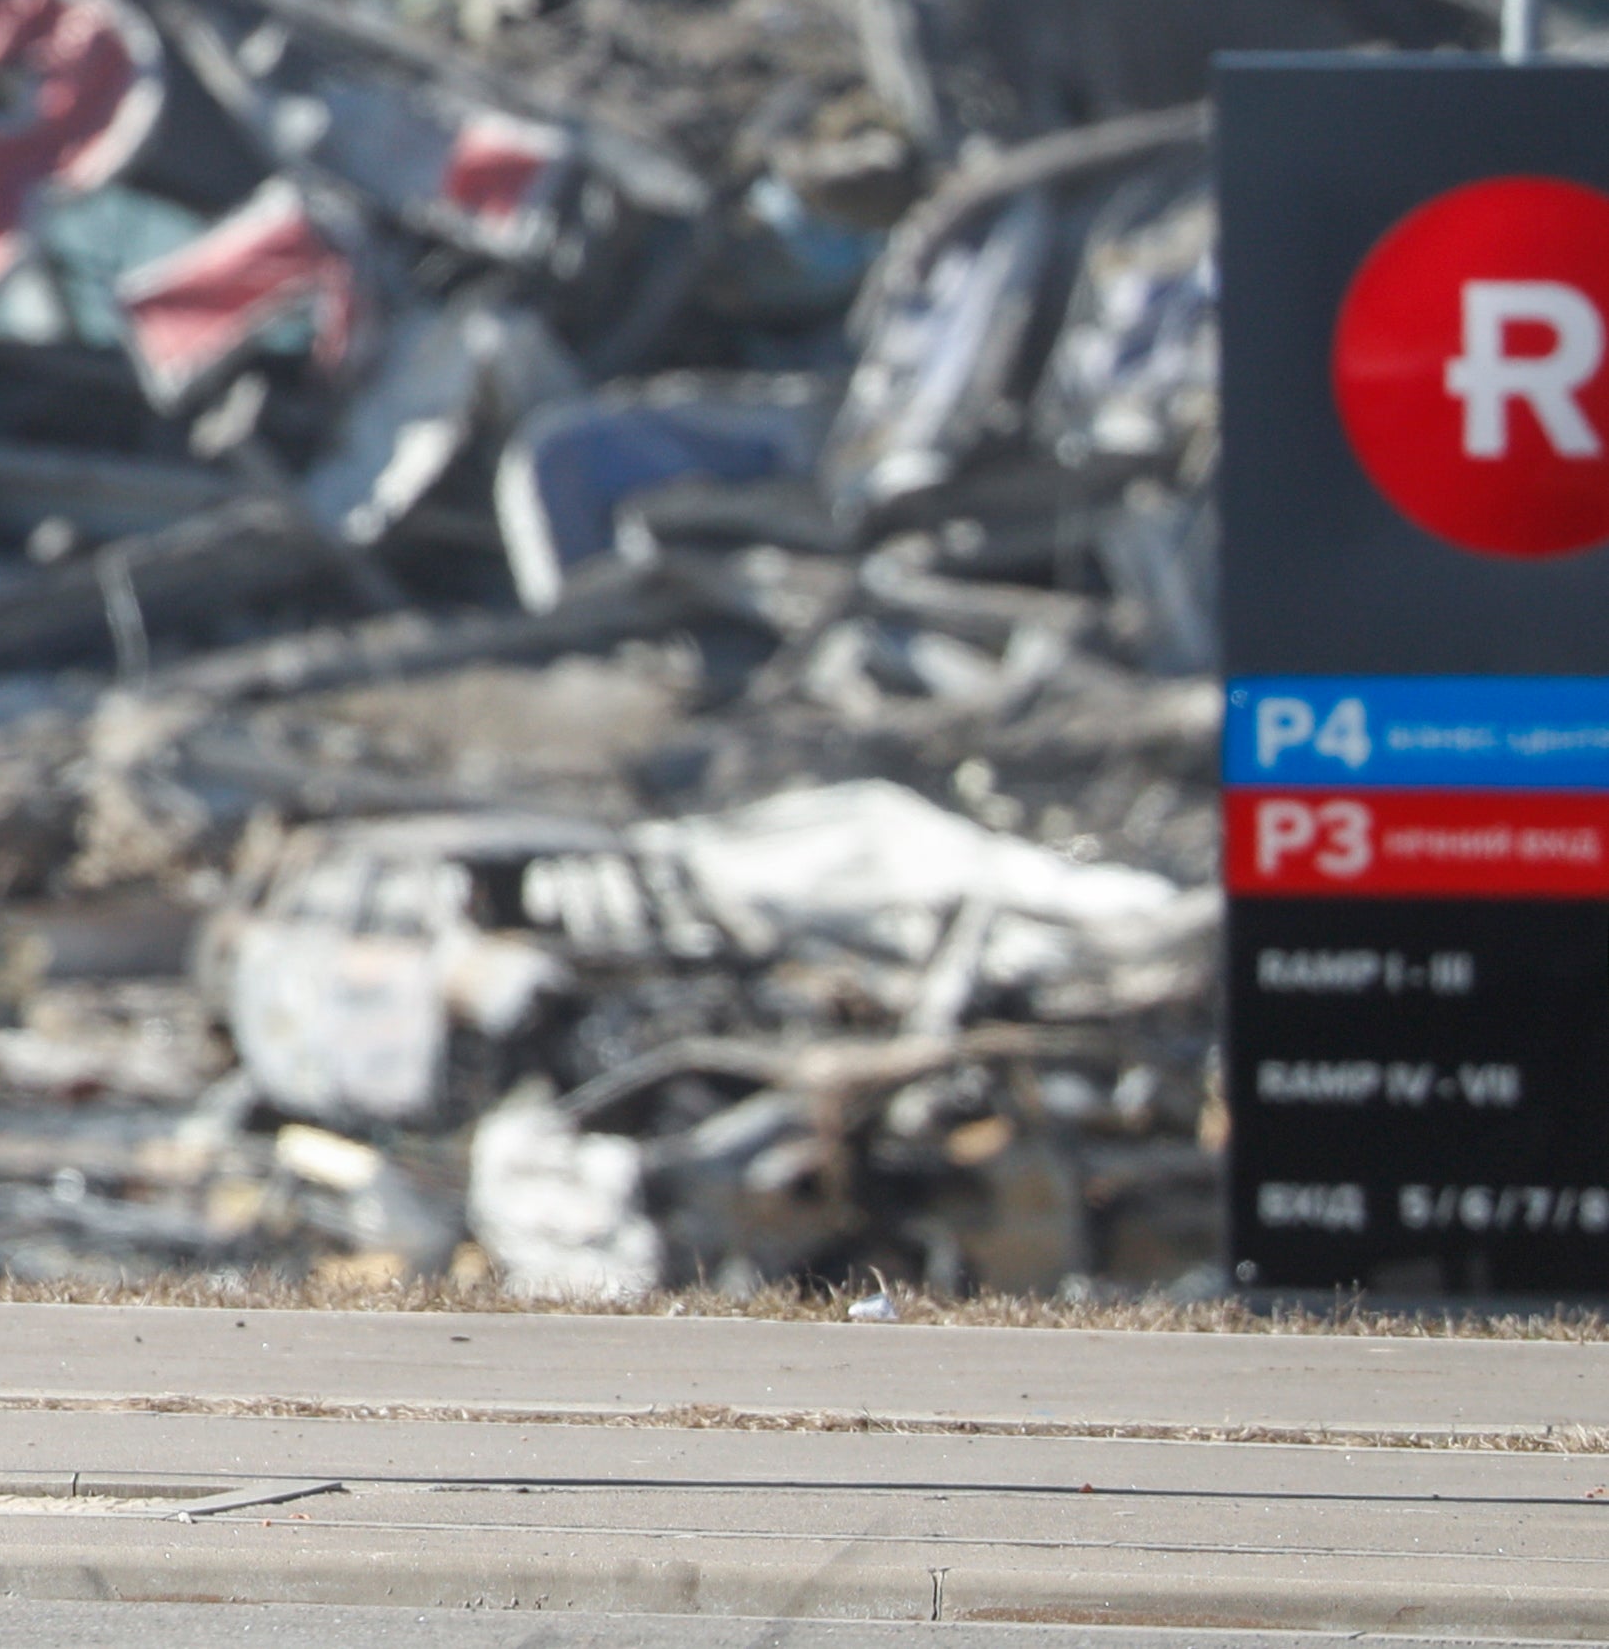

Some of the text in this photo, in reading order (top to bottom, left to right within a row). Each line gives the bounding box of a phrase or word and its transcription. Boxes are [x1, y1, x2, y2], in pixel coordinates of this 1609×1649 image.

[1443, 278, 1608, 460] R
[1255, 696, 1373, 769] P4
[1255, 798, 1374, 878] P3
[1256, 949, 1382, 994] RAMP
[1256, 1059, 1382, 1107] RAMP
